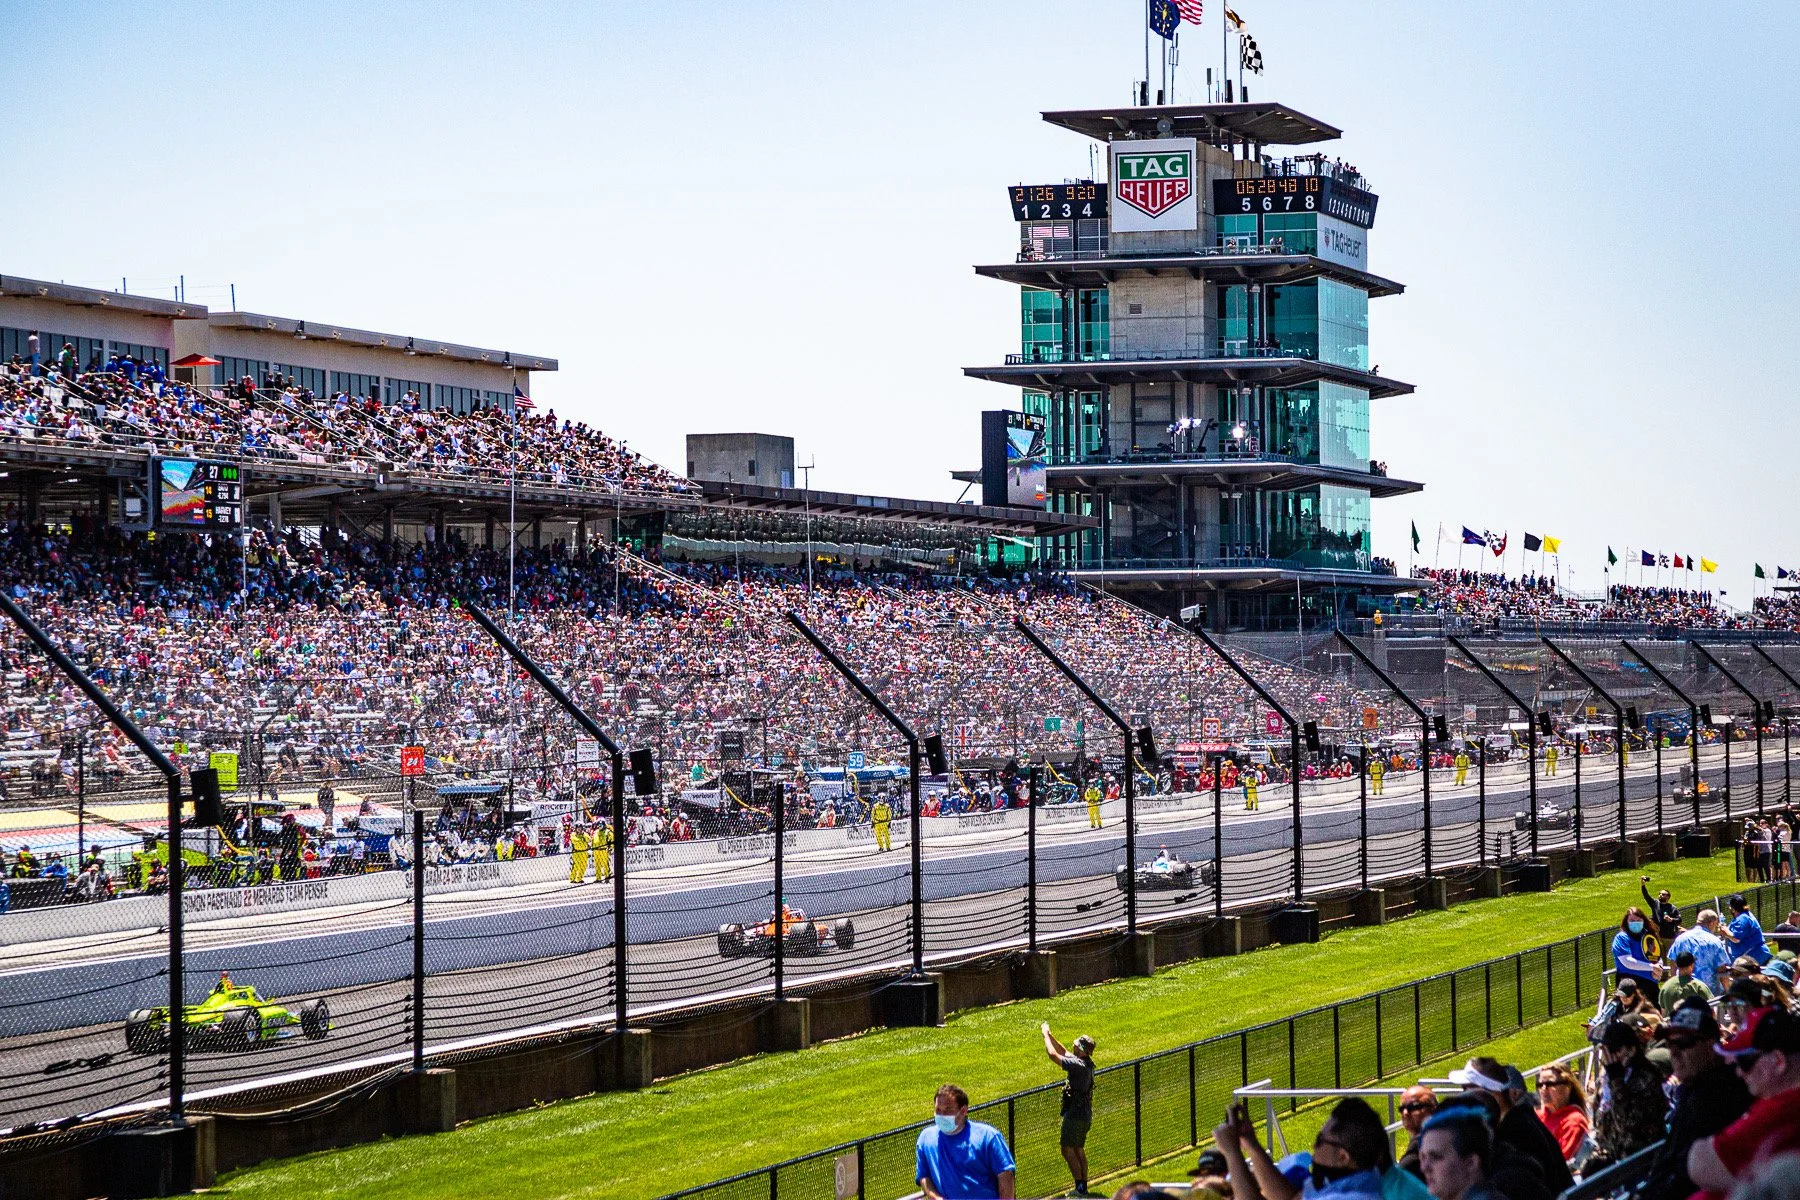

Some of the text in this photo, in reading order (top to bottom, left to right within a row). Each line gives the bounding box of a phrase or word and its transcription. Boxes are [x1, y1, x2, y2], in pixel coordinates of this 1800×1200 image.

[1123, 156, 1183, 177] TAG
[1305, 178, 1318, 192] 10
[1066, 186, 1074, 200] 9
[1122, 181, 1186, 211] HEUER
[1242, 195, 1315, 211] 5 6 7 8
[1021, 202, 1092, 219] 1 2 3 4
[1364, 211, 1370, 225] 10
[209, 465, 219, 479] 27
[205, 485, 213, 495] 14
[205, 508, 213, 519] 15
[1205, 722, 1218, 736] 98
[406, 757, 418, 767] 24
[848, 754, 863, 767] 59
[243, 889, 252, 907] 22
[253, 886, 284, 906] MENARDS
[285, 884, 303, 901] TEAM
[304, 882, 328, 901] PENSKE
